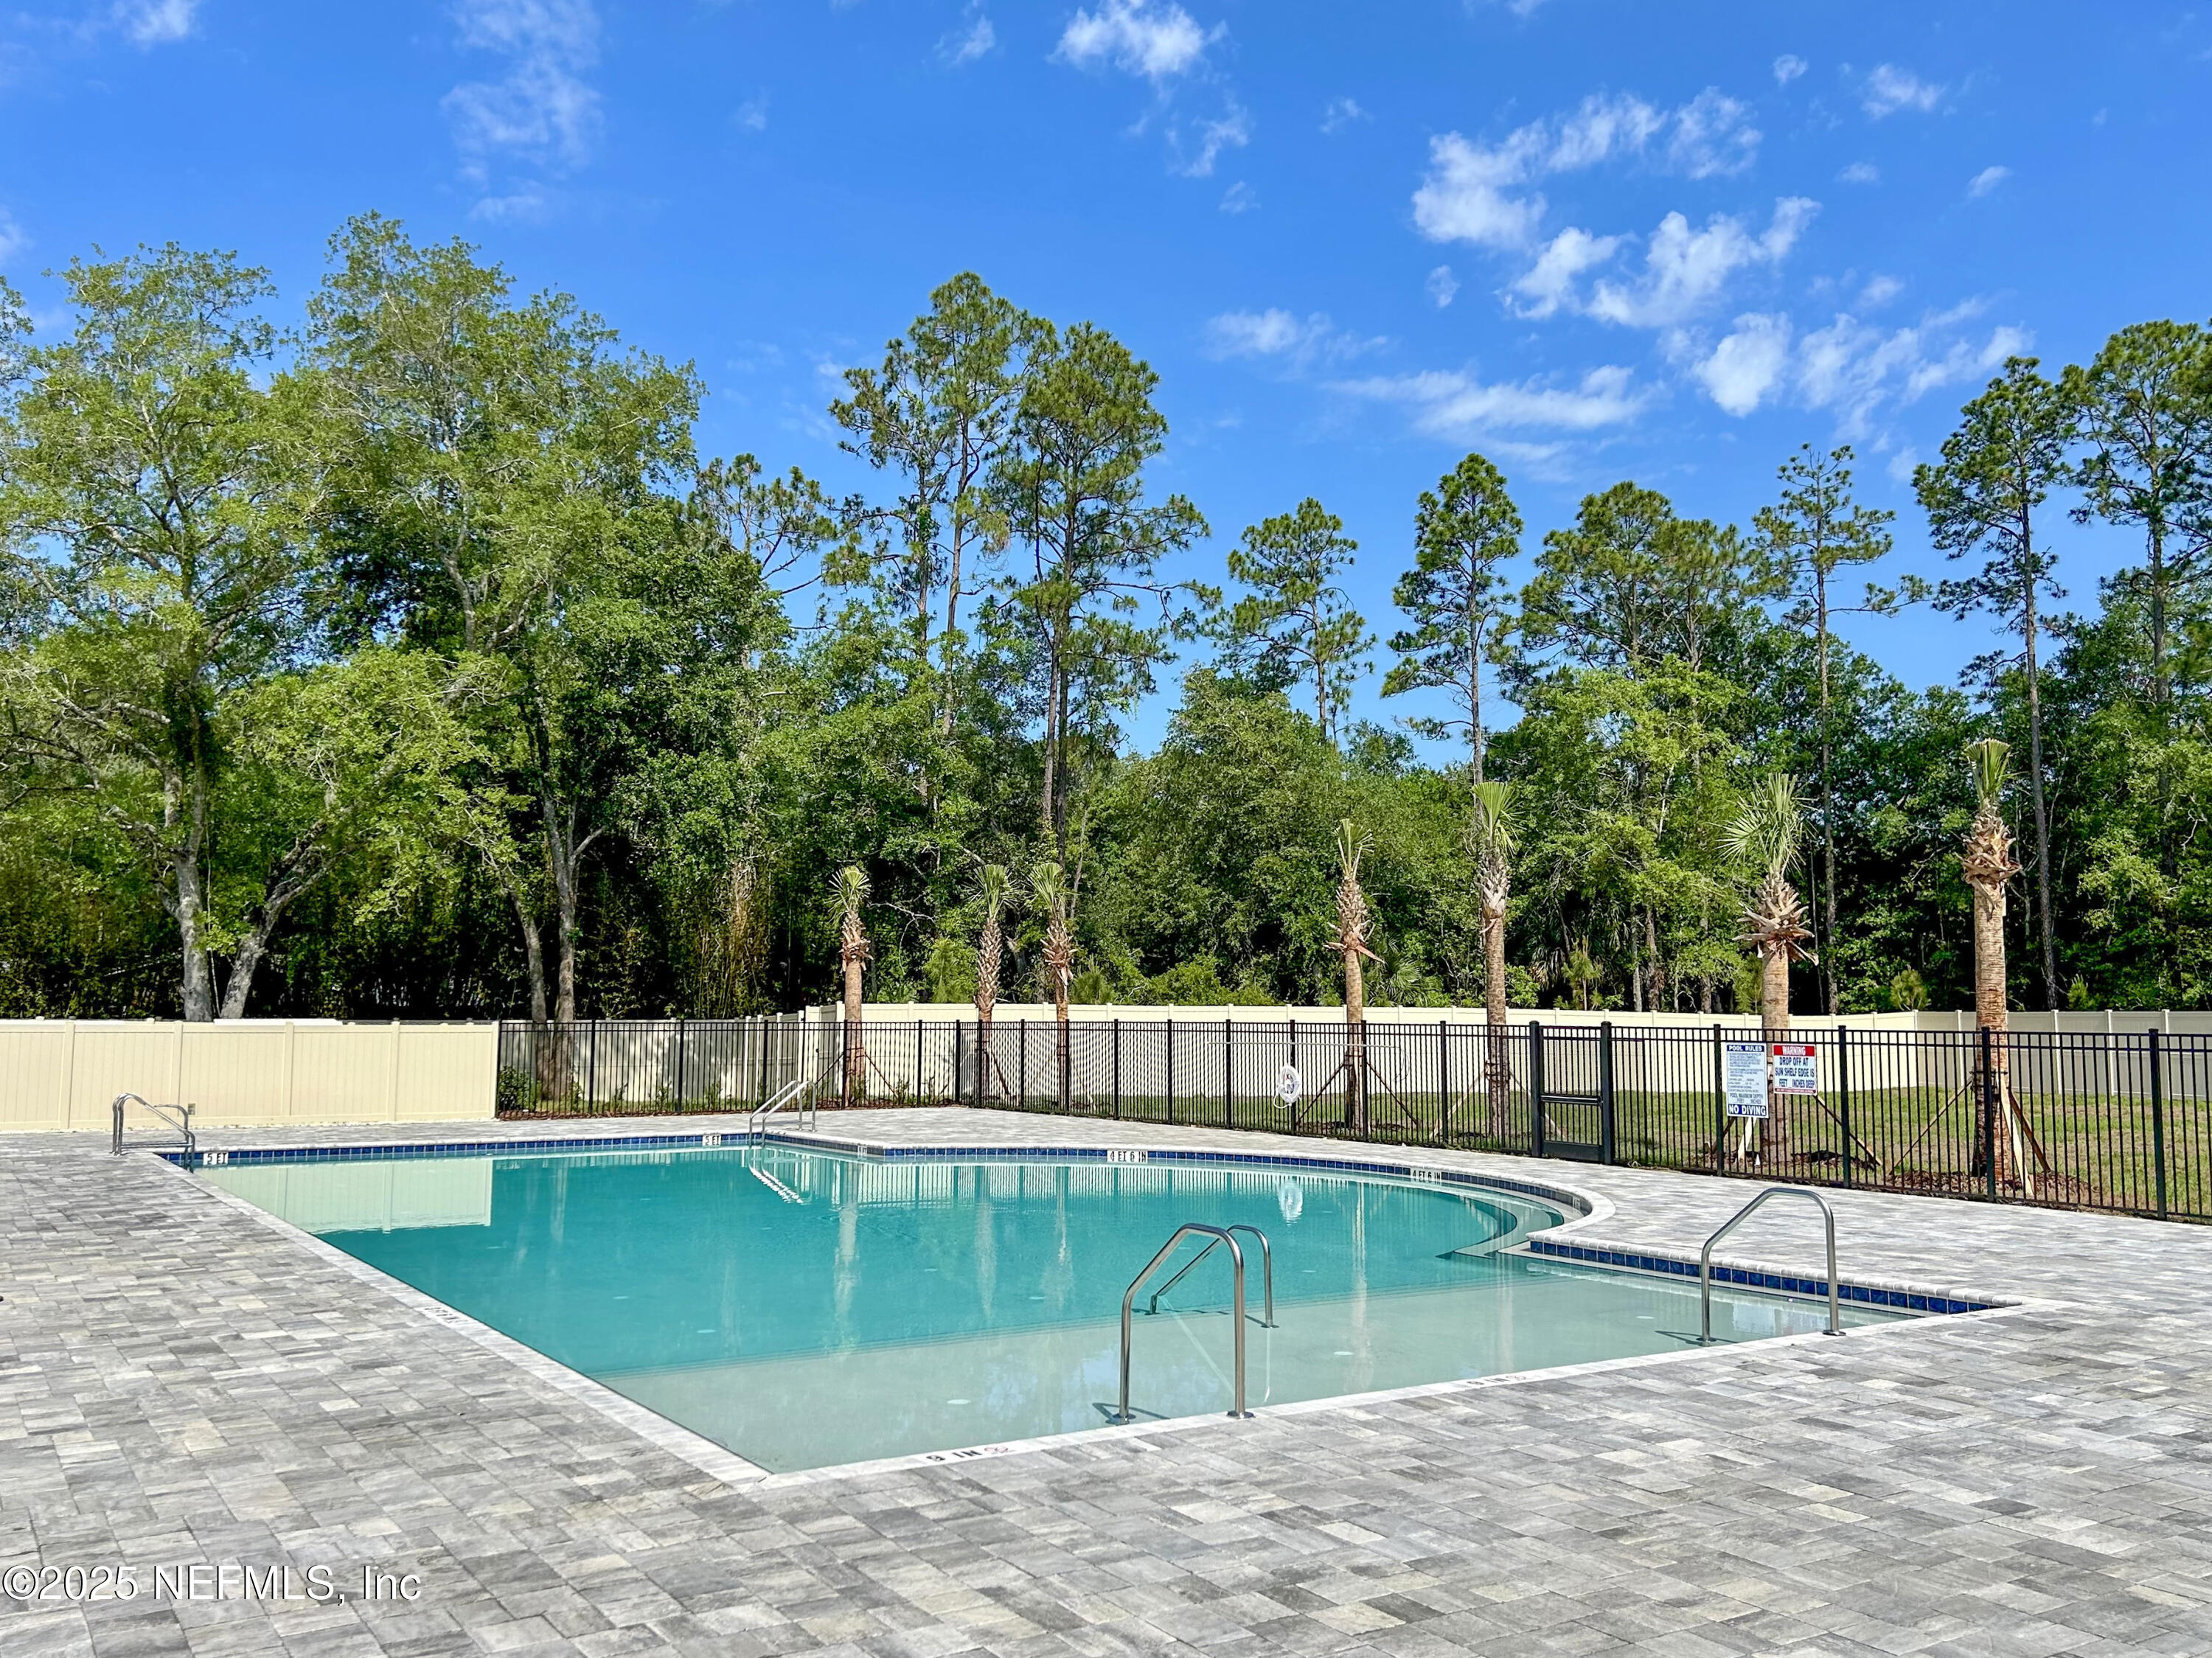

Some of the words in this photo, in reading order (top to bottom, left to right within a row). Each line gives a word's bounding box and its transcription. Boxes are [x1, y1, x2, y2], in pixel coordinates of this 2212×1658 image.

[1782, 1045, 1806, 1055] WARNING
[1779, 1056, 1792, 1065] DROP
[1792, 1057, 1801, 1066] OFF
[1803, 1057, 1809, 1066] AT
[1775, 1067, 1783, 1076] SUN
[1784, 1067, 1797, 1076] SHELF
[1798, 1068, 1809, 1077] EDGE
[1810, 1068, 1815, 1078] IS
[1779, 1079, 1787, 1087] FEET
[1792, 1079, 1805, 1088] INCHES
[1806, 1079, 1815, 1089] DEEP
[1728, 1104, 1739, 1114] NO
[1741, 1105, 1766, 1115] DIVING
[1419, 1170, 1425, 1178] FT
